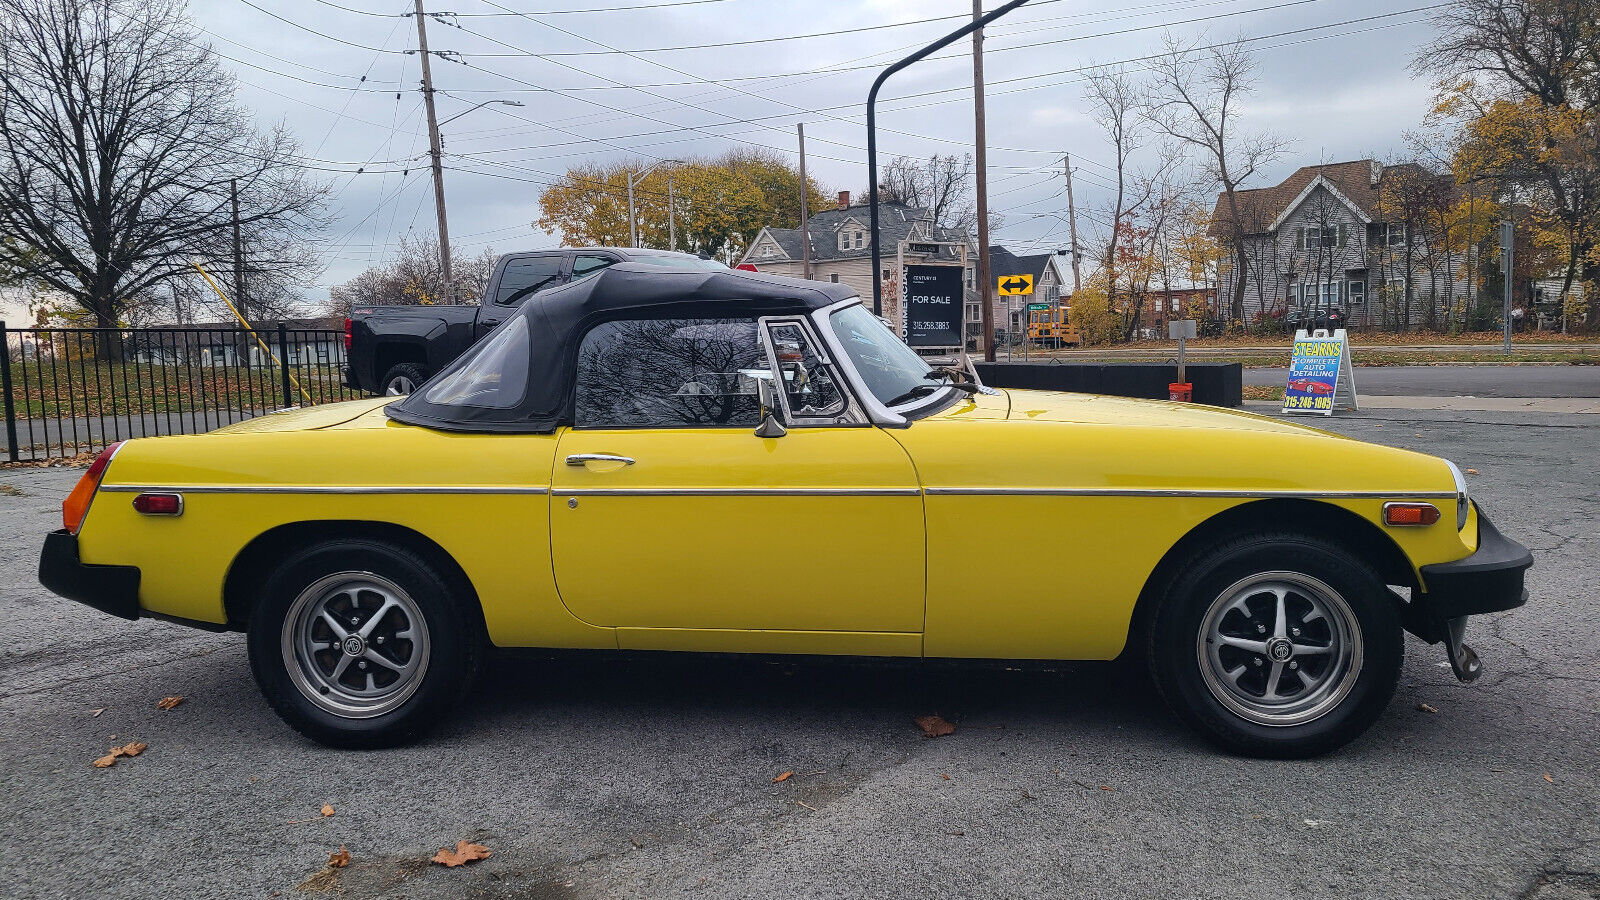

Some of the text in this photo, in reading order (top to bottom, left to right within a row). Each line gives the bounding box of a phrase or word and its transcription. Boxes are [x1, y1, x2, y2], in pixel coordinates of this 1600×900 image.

[912, 295, 951, 305] FOR SALE
[1293, 341, 1341, 357] STEARNS
[1284, 395, 1332, 409] 315-246-1085
[346, 639, 360, 652] MG
[1275, 645, 1288, 657] MG
